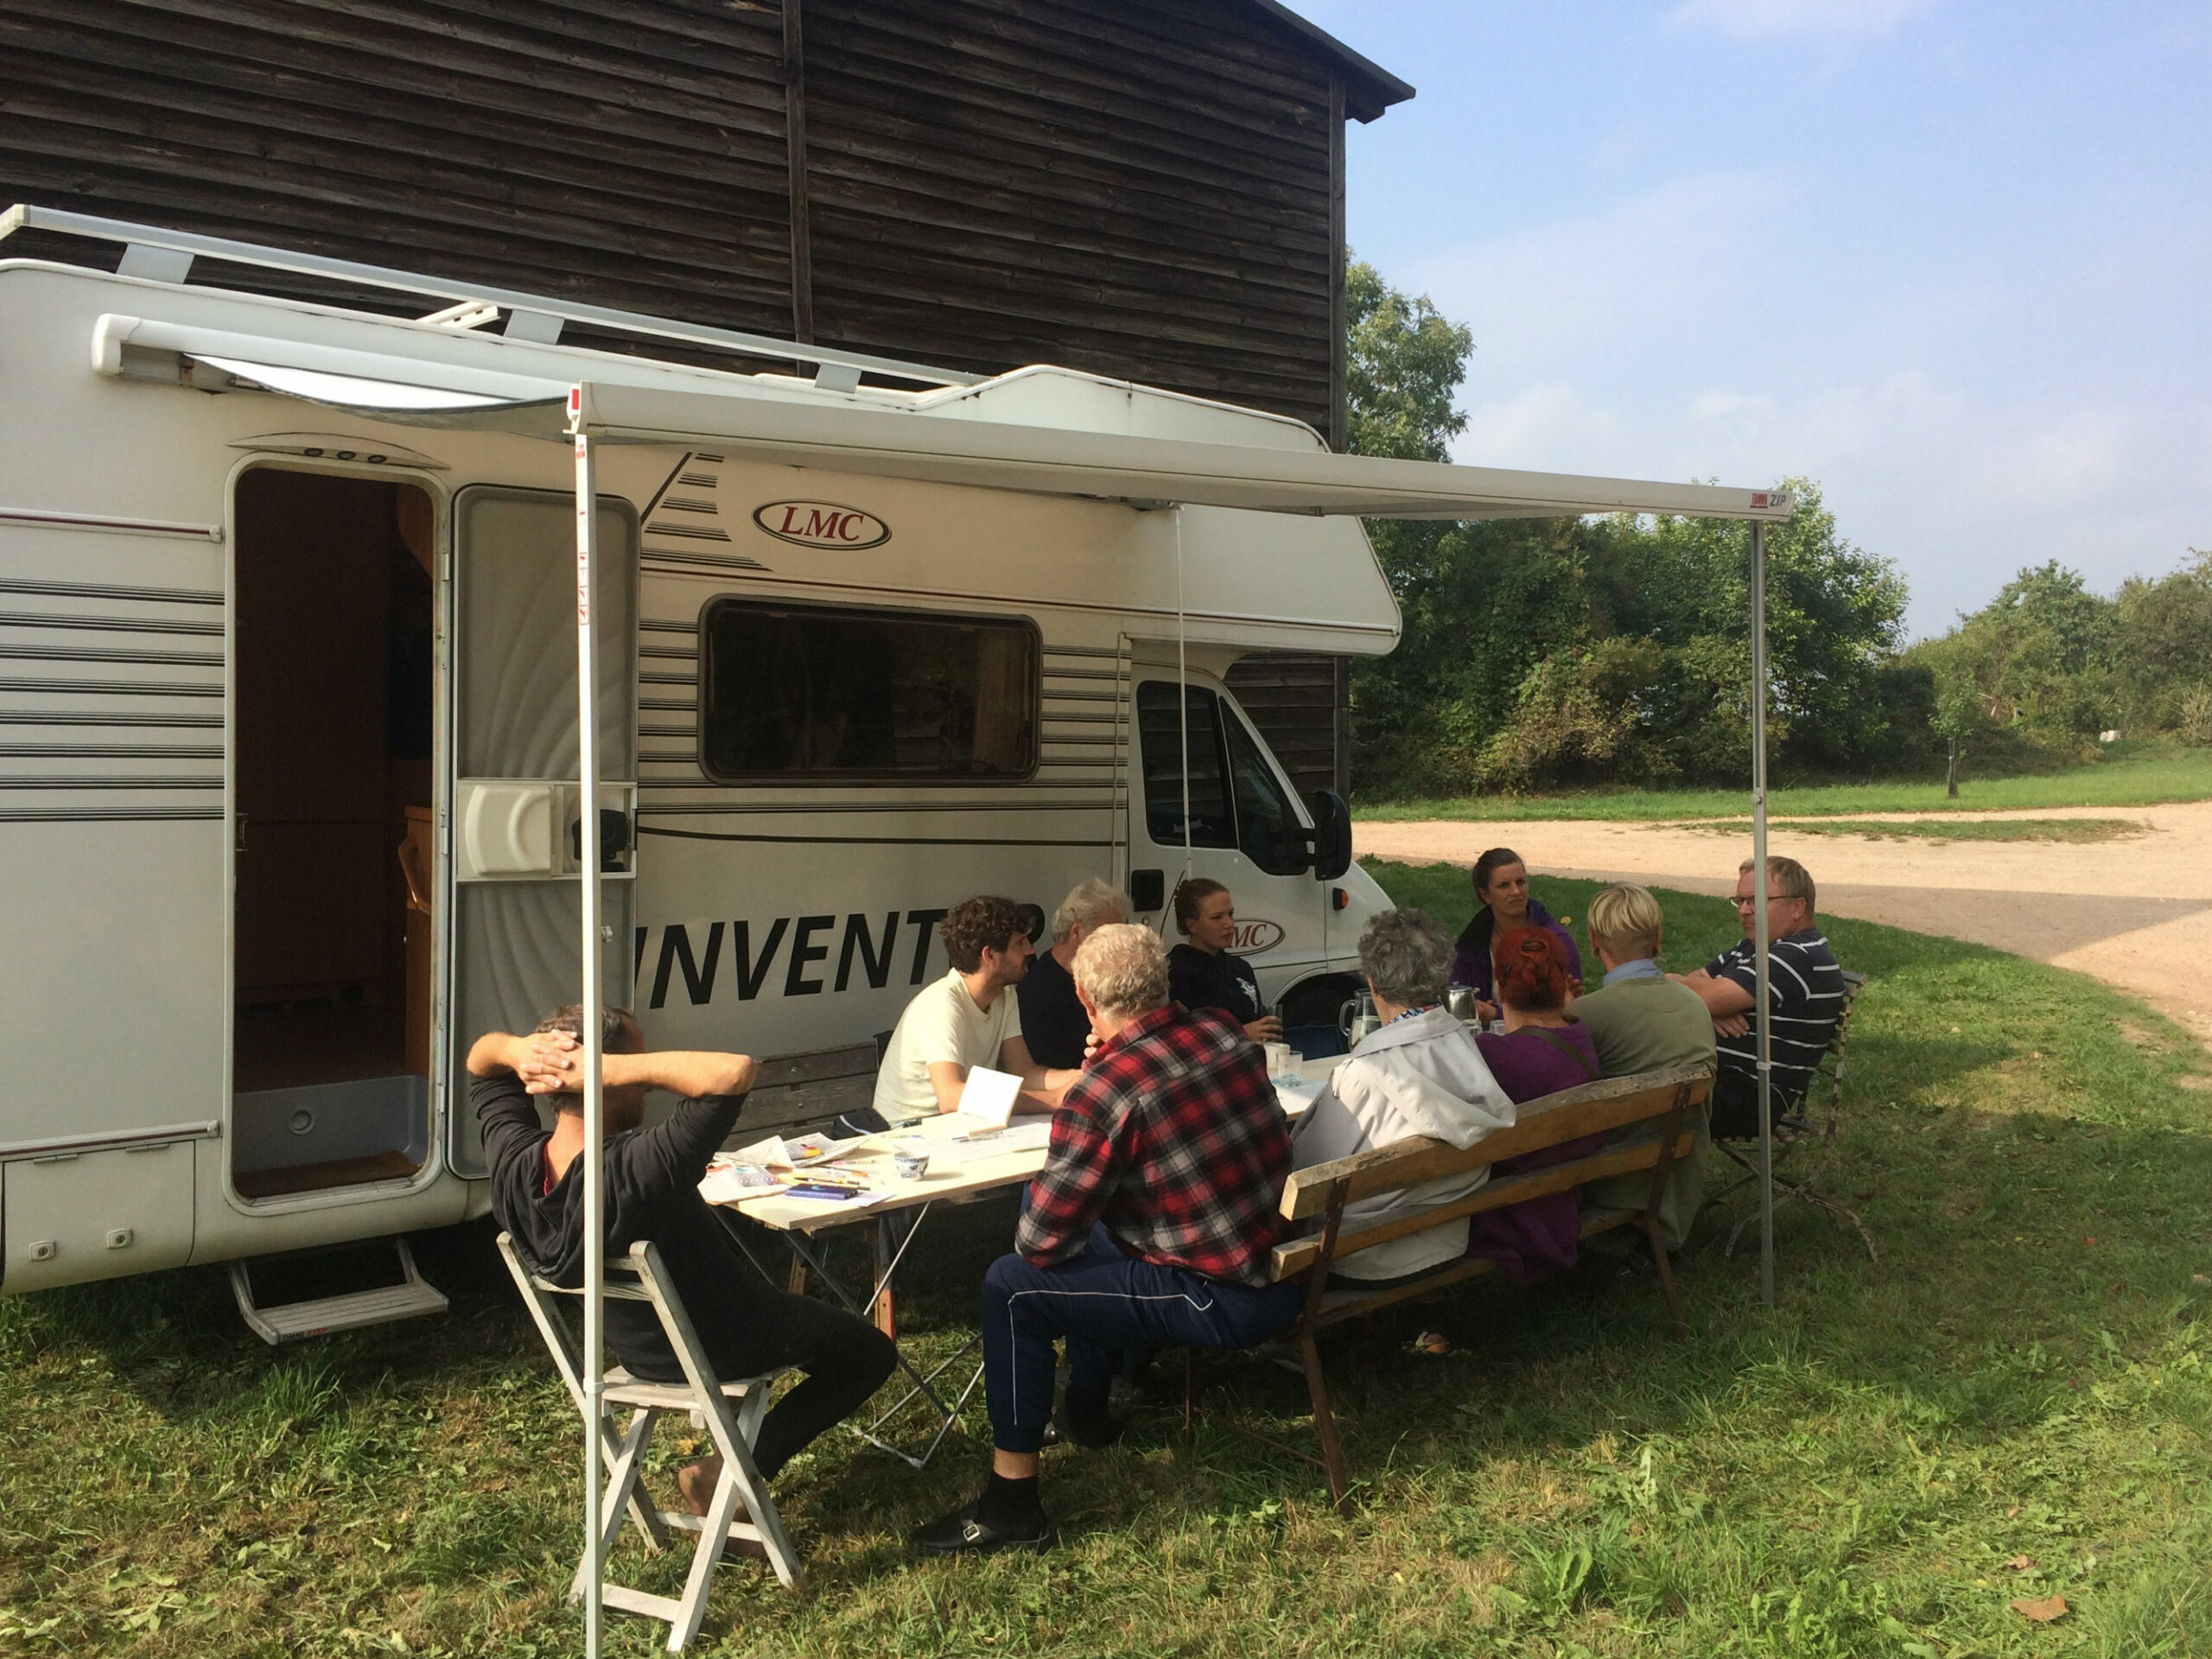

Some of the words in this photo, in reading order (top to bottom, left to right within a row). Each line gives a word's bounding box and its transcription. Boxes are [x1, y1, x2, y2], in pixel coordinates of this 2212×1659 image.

[1769, 493, 1787, 507] ZIP
[779, 505, 864, 542] LMC
[1229, 923, 1268, 949] MC
